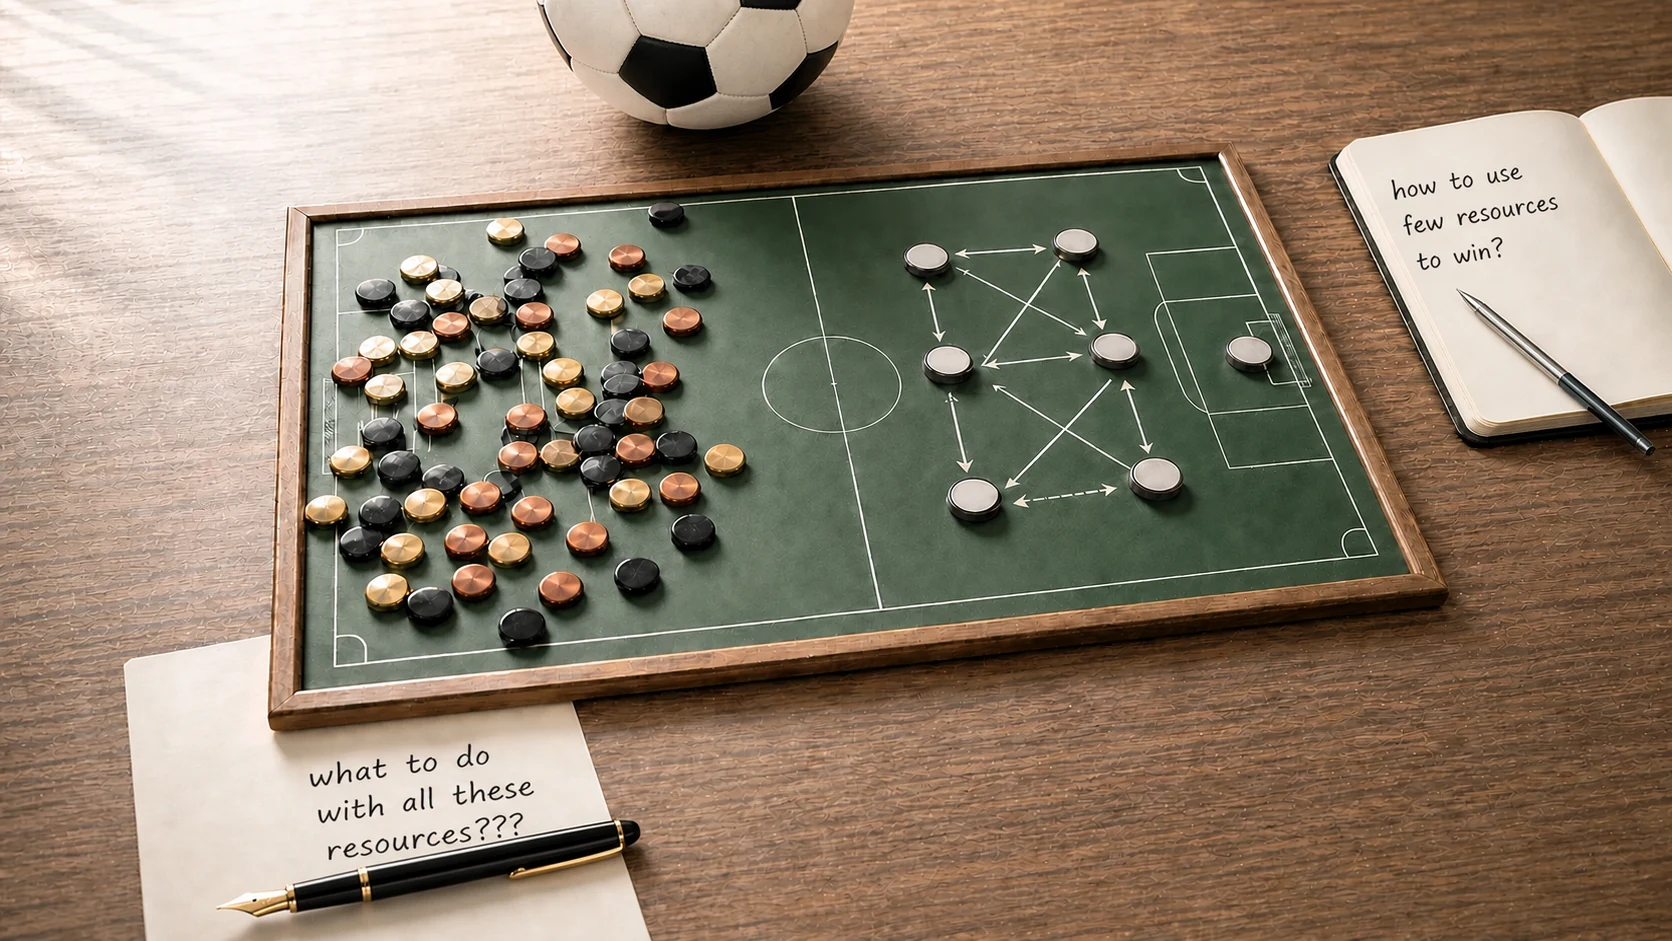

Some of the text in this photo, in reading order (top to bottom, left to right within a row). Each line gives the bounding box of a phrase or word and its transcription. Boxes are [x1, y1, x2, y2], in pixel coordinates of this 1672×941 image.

[1391, 167, 1523, 200] how to use
[1403, 196, 1559, 236] few resources
[1416, 236, 1503, 271] to win?
[309, 743, 490, 788] what to do
[317, 780, 535, 824] with all these
[327, 812, 524, 861] resources???
